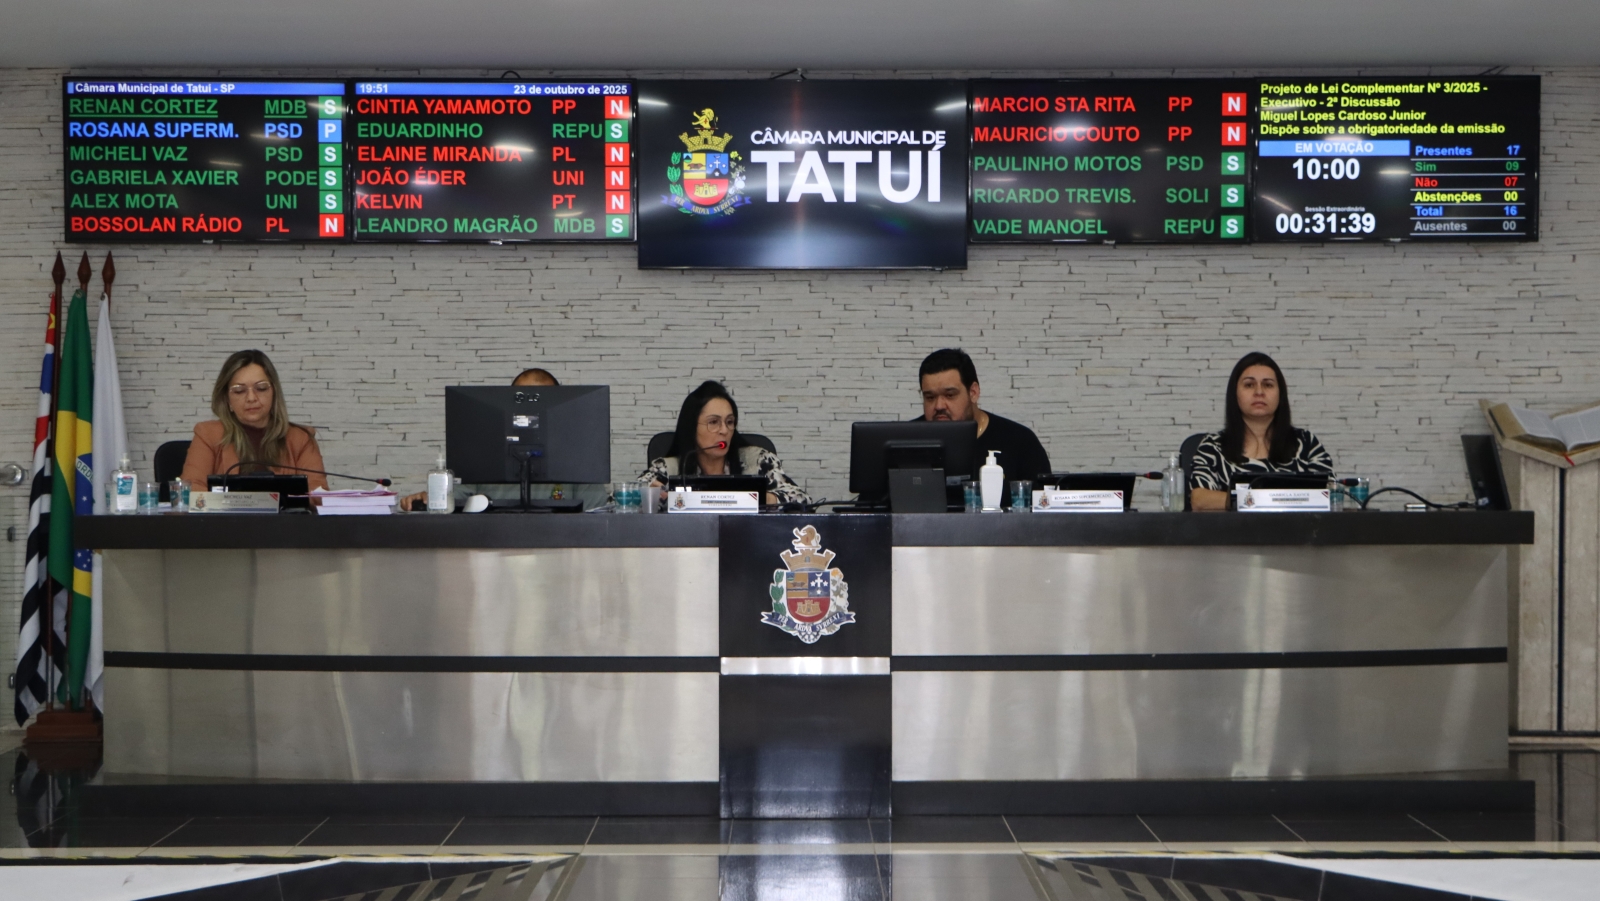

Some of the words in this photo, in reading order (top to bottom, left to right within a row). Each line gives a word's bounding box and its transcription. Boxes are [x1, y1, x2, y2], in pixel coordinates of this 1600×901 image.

[75, 83, 115, 93] Câmara
[118, 83, 167, 94] Municipal
[171, 84, 183, 93] de
[221, 84, 235, 93] SP
[360, 84, 388, 93] 19:51
[514, 85, 526, 94] 23
[529, 85, 541, 94] de
[544, 85, 585, 94] outubro
[588, 85, 600, 94] de
[603, 85, 627, 94] 2025
[1261, 84, 1301, 96] Projeto
[1304, 84, 1318, 93] de
[1321, 83, 1338, 93] Lei
[1341, 83, 1424, 94] Complementar
[1444, 83, 1480, 93] 3/2025
[69, 100, 135, 114] RENAN
[141, 99, 218, 114] CORTEZ
[265, 100, 306, 115] MDB
[324, 100, 336, 114] S
[357, 99, 418, 114] CINTIA
[423, 99, 532, 114] YAMAMOTO
[552, 100, 575, 114] PP
[611, 100, 623, 114] N
[974, 97, 1049, 112] MARCIO
[1055, 97, 1089, 112] STA
[1095, 97, 1135, 112] RITA
[1168, 97, 1192, 111] PP
[1228, 97, 1240, 111] N
[1261, 97, 1316, 107] Executivo
[1327, 97, 1338, 107] 2ª
[1341, 97, 1400, 107] Discussão
[1261, 111, 1297, 123] Miguel
[1300, 111, 1335, 123] Lopes
[1338, 110, 1386, 120] Cardoso
[1389, 111, 1426, 120] Junior
[69, 122, 149, 138] ROSANA
[154, 123, 239, 138] SUPERM.
[265, 123, 302, 138] PSD
[325, 123, 336, 137] P
[358, 124, 482, 138] EDUARDINHO
[553, 124, 603, 138] REPU
[611, 124, 622, 138] S
[751, 127, 825, 144] CÂMARA
[828, 130, 921, 144] MUNICIPAL
[922, 131, 945, 144] DE
[974, 127, 1067, 141] MAURICIO
[1073, 127, 1140, 141] COUTO
[1168, 127, 1192, 141] PP
[1228, 127, 1240, 141] N
[1261, 124, 1300, 136] Dispõe
[1303, 124, 1335, 134] sobre
[1338, 126, 1345, 134] a
[1348, 123, 1437, 136] obrigatoriedade
[1440, 123, 1454, 133] da
[1457, 123, 1505, 133] emissão
[70, 147, 146, 161] MICHELI
[152, 147, 187, 161] VAZ
[266, 147, 302, 162] PSD
[325, 148, 336, 162] S
[358, 147, 426, 161] ELAINE
[433, 147, 522, 161] MIRANDA
[553, 147, 575, 161] PL
[611, 148, 623, 161] N
[1295, 143, 1312, 153] EM
[1315, 141, 1374, 154] VOTAÇÃO
[1415, 145, 1472, 156] Presentes
[1507, 145, 1520, 155] 17
[974, 157, 1068, 171] PAULINHO
[1074, 156, 1141, 171] MOTOS
[1166, 156, 1203, 171] PSD
[1227, 156, 1239, 171] S
[1293, 158, 1360, 179] 10:00
[1415, 162, 1436, 171] Sim
[1506, 161, 1519, 171] 09
[70, 171, 166, 185] GABRIELA
[171, 171, 239, 185] XAVIER
[266, 171, 317, 185] PODE
[325, 171, 336, 185] S
[357, 167, 409, 185] JOÃO
[415, 167, 466, 185] ÉDER
[553, 171, 584, 185] UNI
[611, 171, 623, 185] N
[751, 144, 945, 203] TATUÍ
[1415, 177, 1438, 187] Não
[1505, 177, 1518, 186] 07
[71, 194, 119, 208] ALEX
[126, 194, 178, 208] MOTA
[266, 194, 297, 209] UNI
[325, 195, 336, 209] S
[357, 195, 422, 209] KELVIN
[553, 195, 575, 209] PT
[611, 195, 623, 209] N
[974, 188, 1059, 203] RICARDO
[1065, 188, 1136, 203] TREVIS.
[1166, 188, 1208, 203] SOLI
[1227, 188, 1238, 203] S
[1414, 191, 1481, 203] Abstenções
[1504, 191, 1518, 201] 00
[1415, 206, 1442, 216] Total
[1504, 206, 1517, 215] 16
[71, 217, 176, 232] BOSSOLAN
[182, 213, 242, 232] RÁDIO
[266, 218, 289, 232] PL
[326, 218, 337, 232] N
[357, 218, 447, 233] LEANDRO
[454, 215, 537, 233] MAGRÃO
[555, 218, 595, 233] MDB
[612, 218, 623, 233] S
[973, 220, 1022, 234] VADE
[1028, 220, 1107, 234] MANOEL
[1165, 220, 1214, 234] REPU
[1226, 220, 1238, 234] S
[1276, 213, 1375, 233] 00:31:39
[1414, 221, 1467, 231] Ausentes
[1503, 221, 1516, 230] 00
